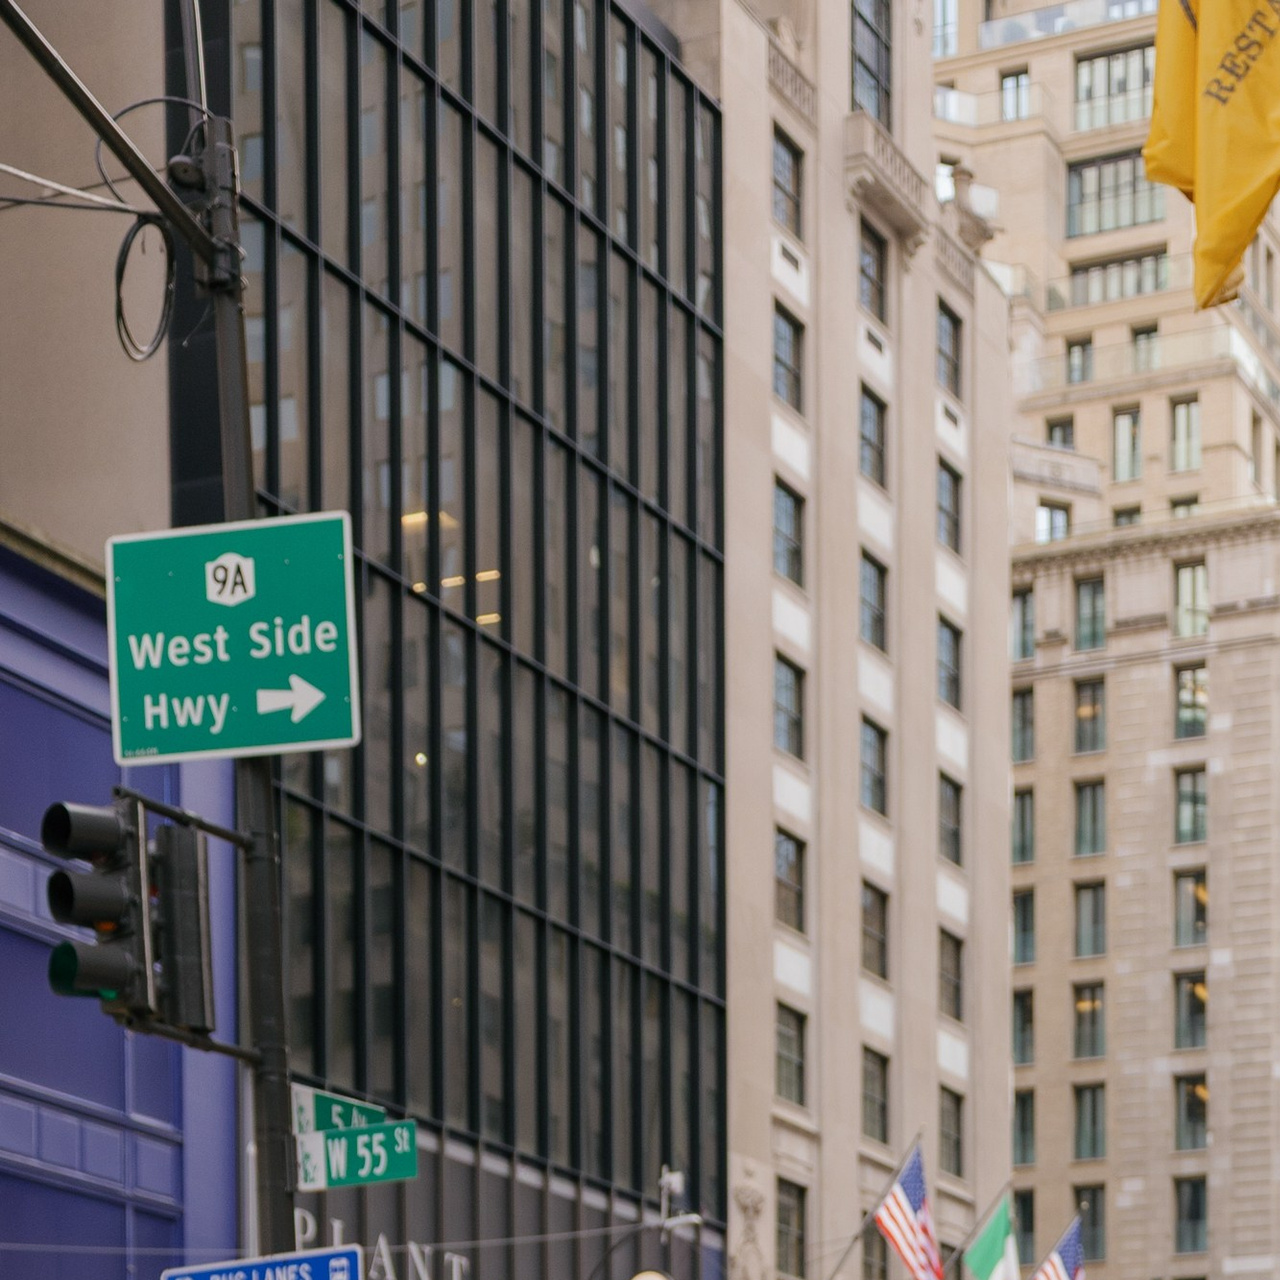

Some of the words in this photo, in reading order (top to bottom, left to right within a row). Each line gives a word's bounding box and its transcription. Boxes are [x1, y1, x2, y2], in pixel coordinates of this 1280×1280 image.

[212, 563, 249, 597] 9A
[127, 625, 231, 671] West
[249, 614, 339, 659] Side
[143, 692, 230, 735] Hwy
[326, 1136, 349, 1180] W
[356, 1132, 388, 1178] 55
[393, 1126, 411, 1154] St
